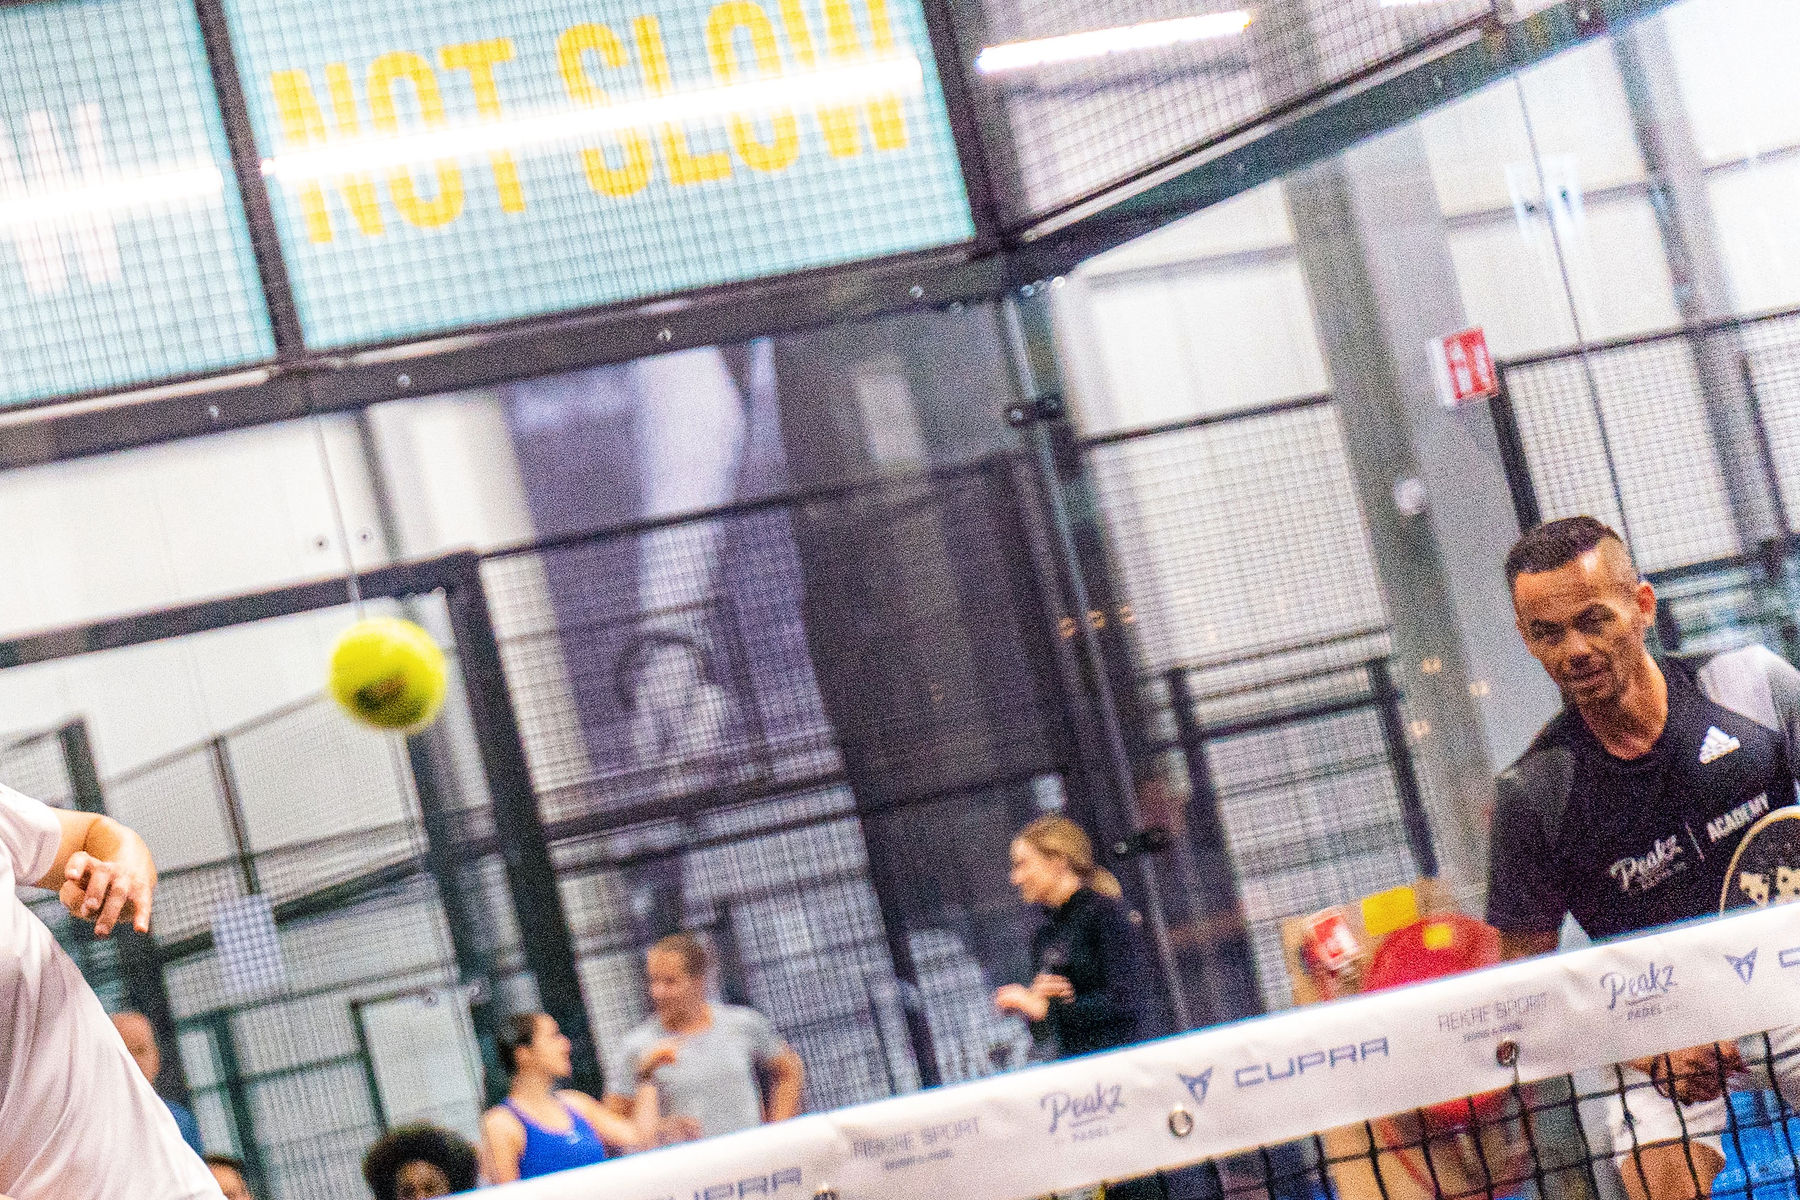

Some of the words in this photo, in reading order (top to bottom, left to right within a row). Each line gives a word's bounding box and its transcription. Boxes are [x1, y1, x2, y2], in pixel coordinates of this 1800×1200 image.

[269, 36, 529, 246] NOT
[553, 0, 909, 201] SLOW
[1599, 961, 1678, 1012] Peakz
[1233, 1036, 1391, 1090] CUPRA
[1039, 1080, 1125, 1135] Peakz
